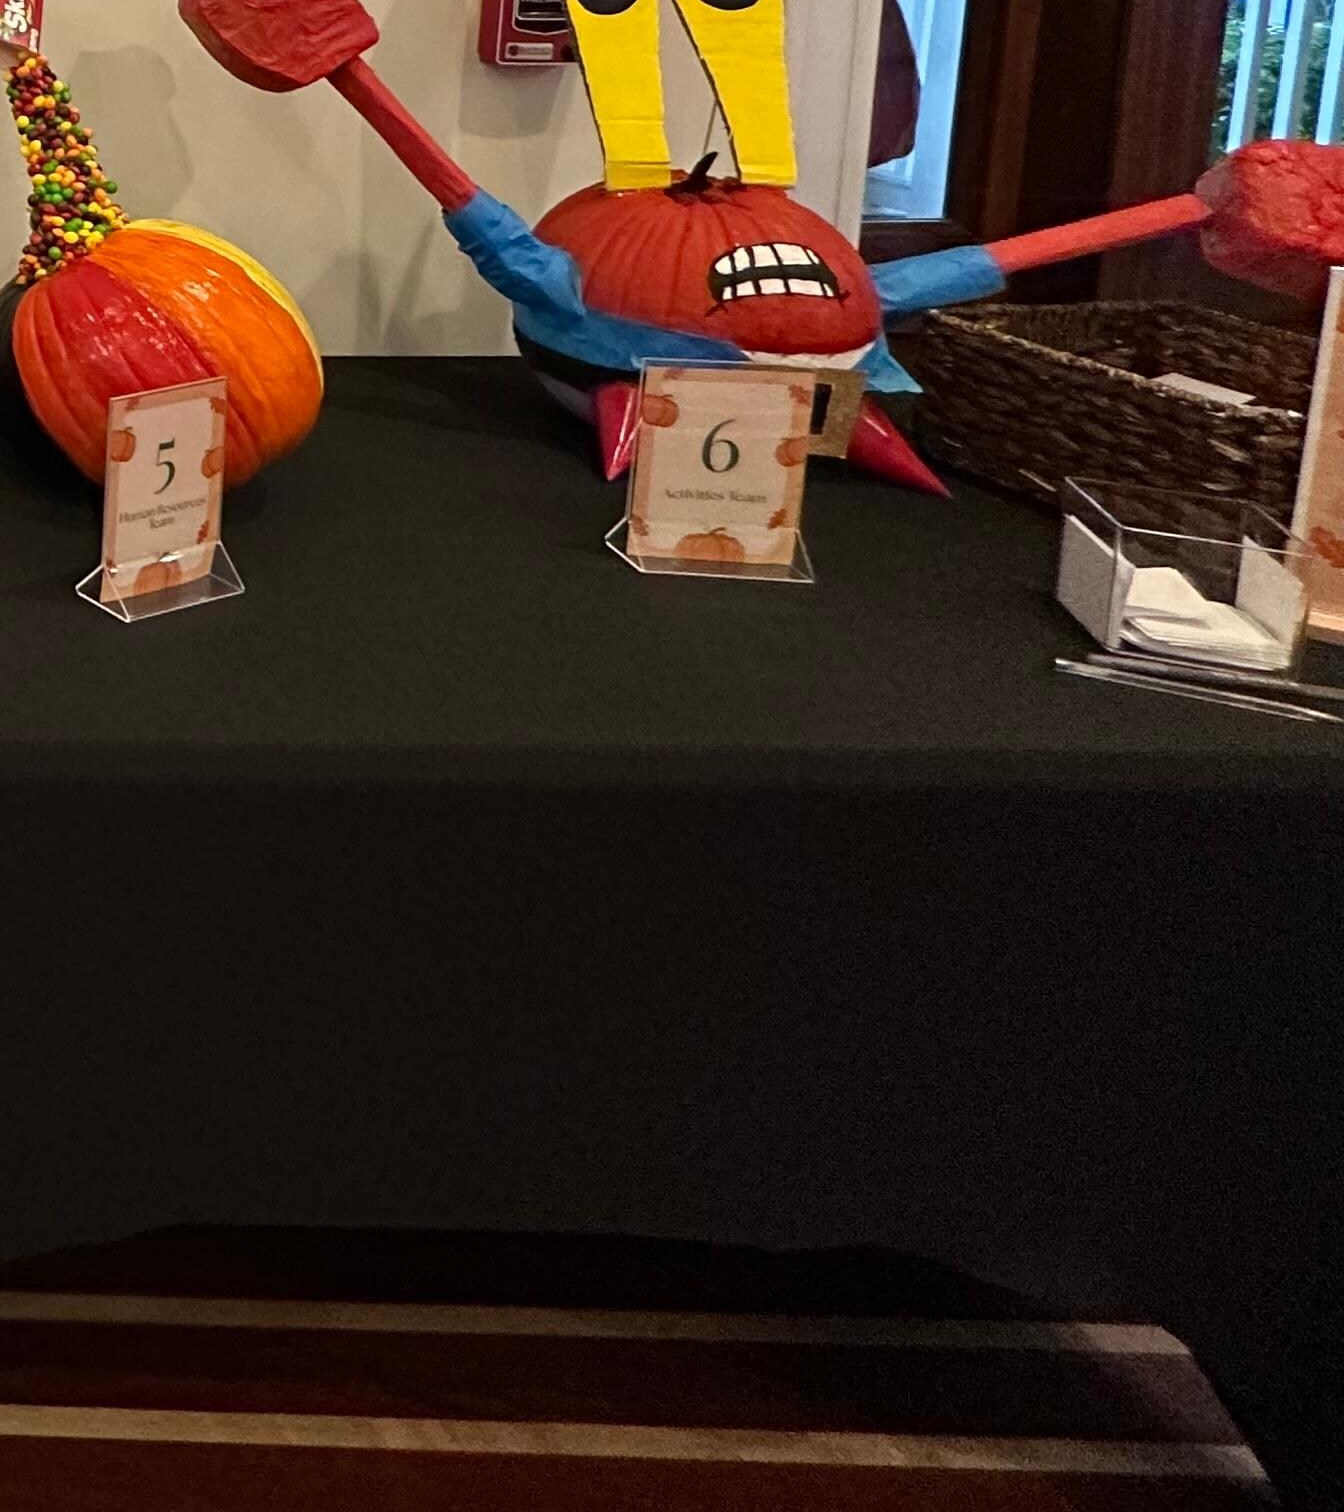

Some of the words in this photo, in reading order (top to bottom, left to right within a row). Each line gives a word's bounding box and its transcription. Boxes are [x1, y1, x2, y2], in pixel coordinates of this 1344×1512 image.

[702, 419, 740, 473] 6
[153, 437, 176, 495] 5
[665, 488, 725, 501] Activities
[729, 490, 767, 504] Team
[118, 508, 156, 524] Human
[156, 498, 207, 515] Resources
[149, 516, 176, 530] Team
